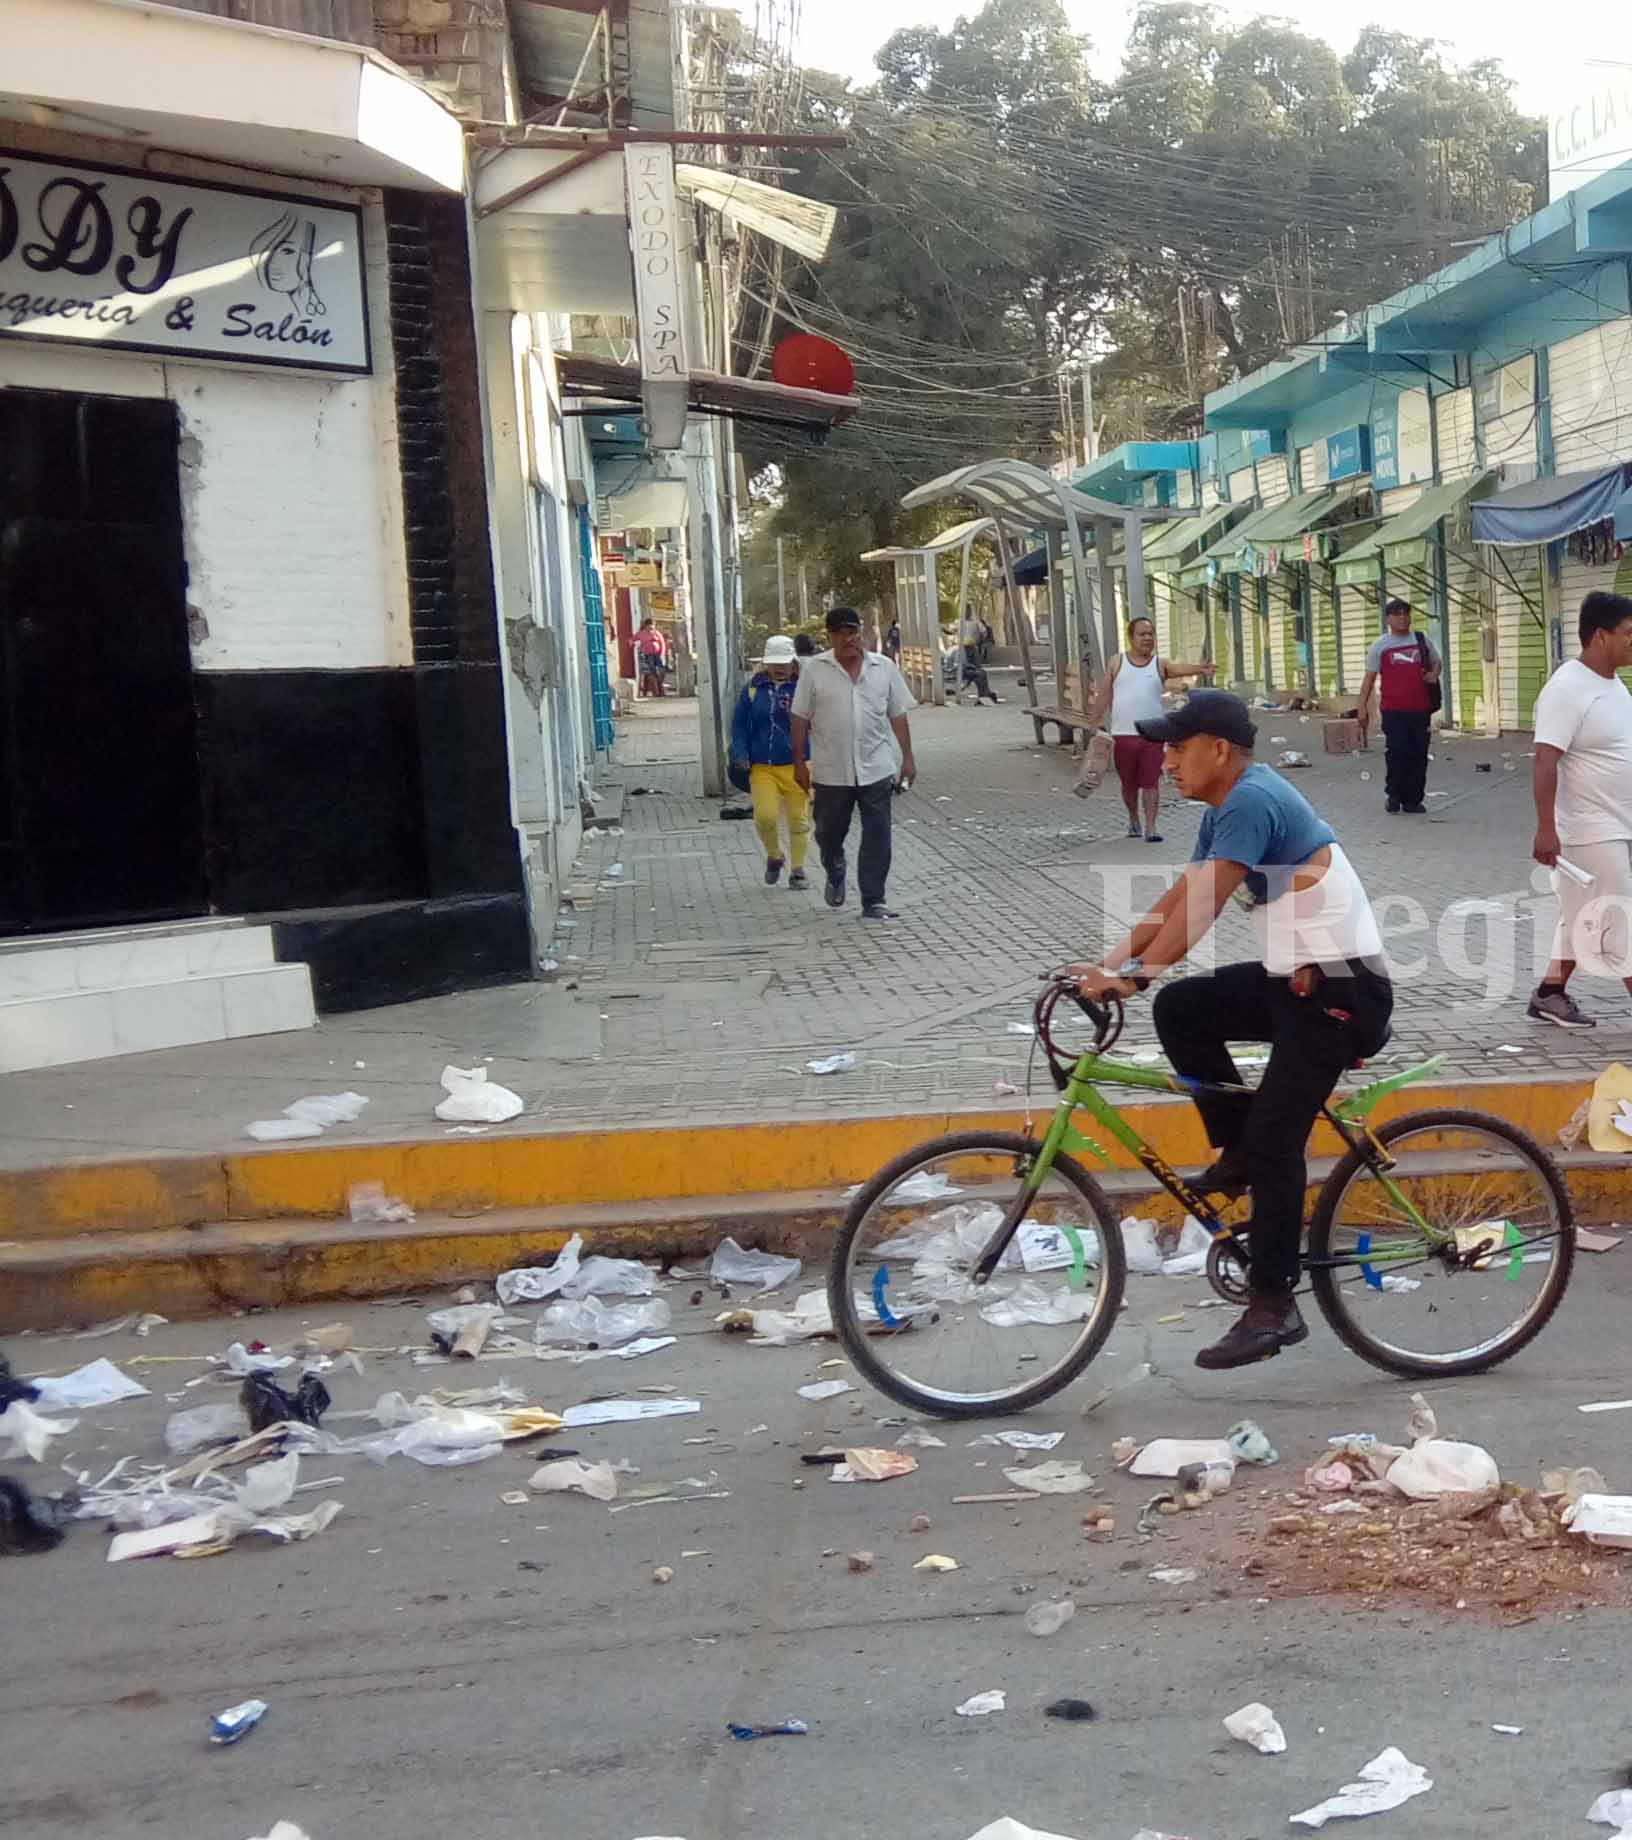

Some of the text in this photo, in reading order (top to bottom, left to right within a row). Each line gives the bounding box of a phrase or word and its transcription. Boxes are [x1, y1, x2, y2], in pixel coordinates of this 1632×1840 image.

[0, 167, 193, 295] DY
[638, 155, 688, 375] EXODO SPA
[165, 297, 194, 330] &
[222, 303, 333, 347] Salón
